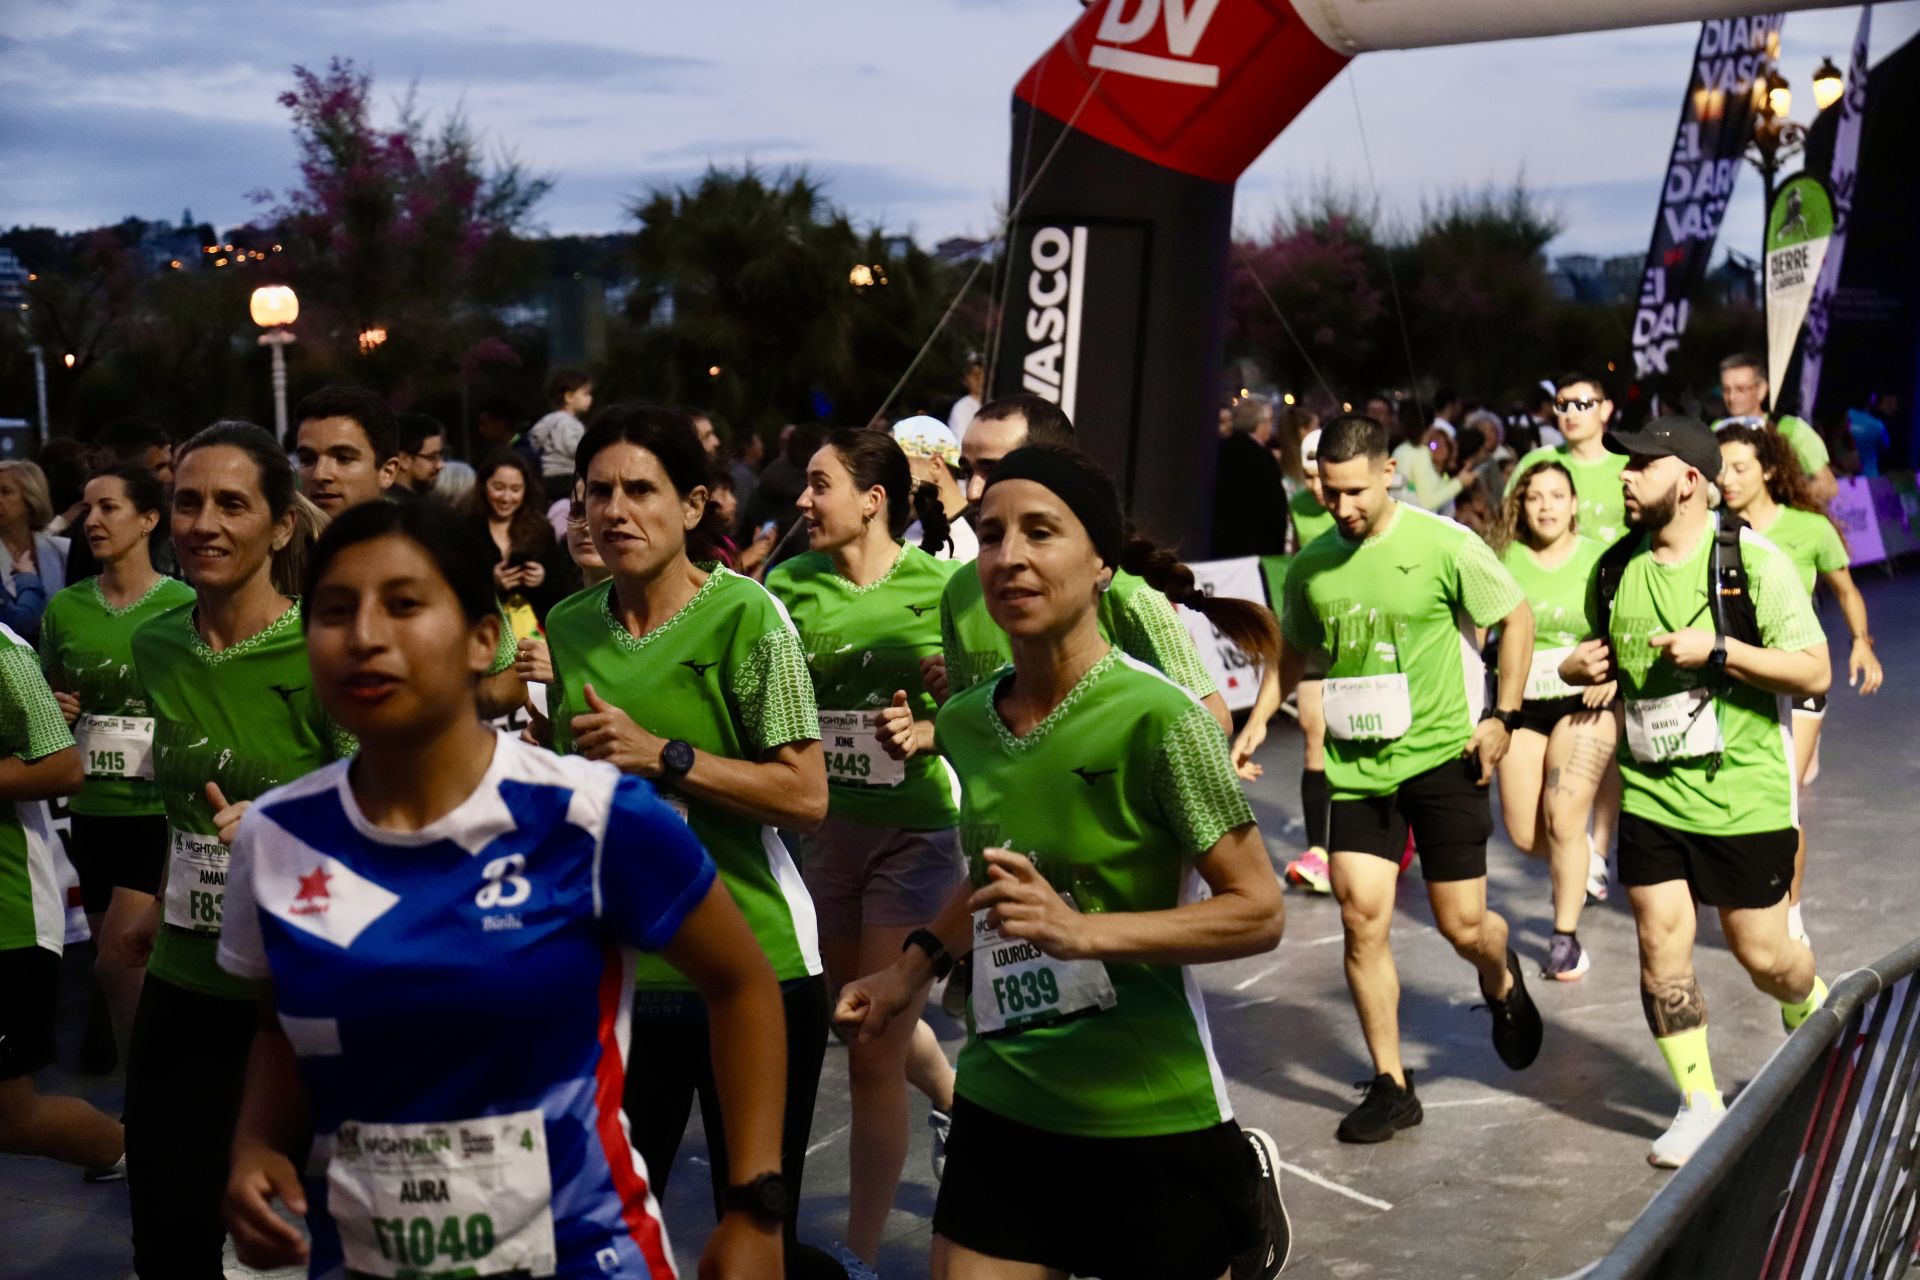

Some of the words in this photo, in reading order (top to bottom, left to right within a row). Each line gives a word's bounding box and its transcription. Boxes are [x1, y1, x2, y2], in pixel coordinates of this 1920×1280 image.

[1096, 0, 1220, 58] DV
[143, 722, 152, 734] 4
[1347, 713, 1383, 732] 1401
[835, 736, 854, 748] JONE
[89, 750, 125, 770] 1415
[823, 751, 871, 776] F443
[199, 870, 227, 886] AMAI
[992, 942, 1042, 968] LOURDES
[992, 967, 1060, 1015] F839
[519, 1127, 534, 1152] 4
[400, 1178, 450, 1203] AURA
